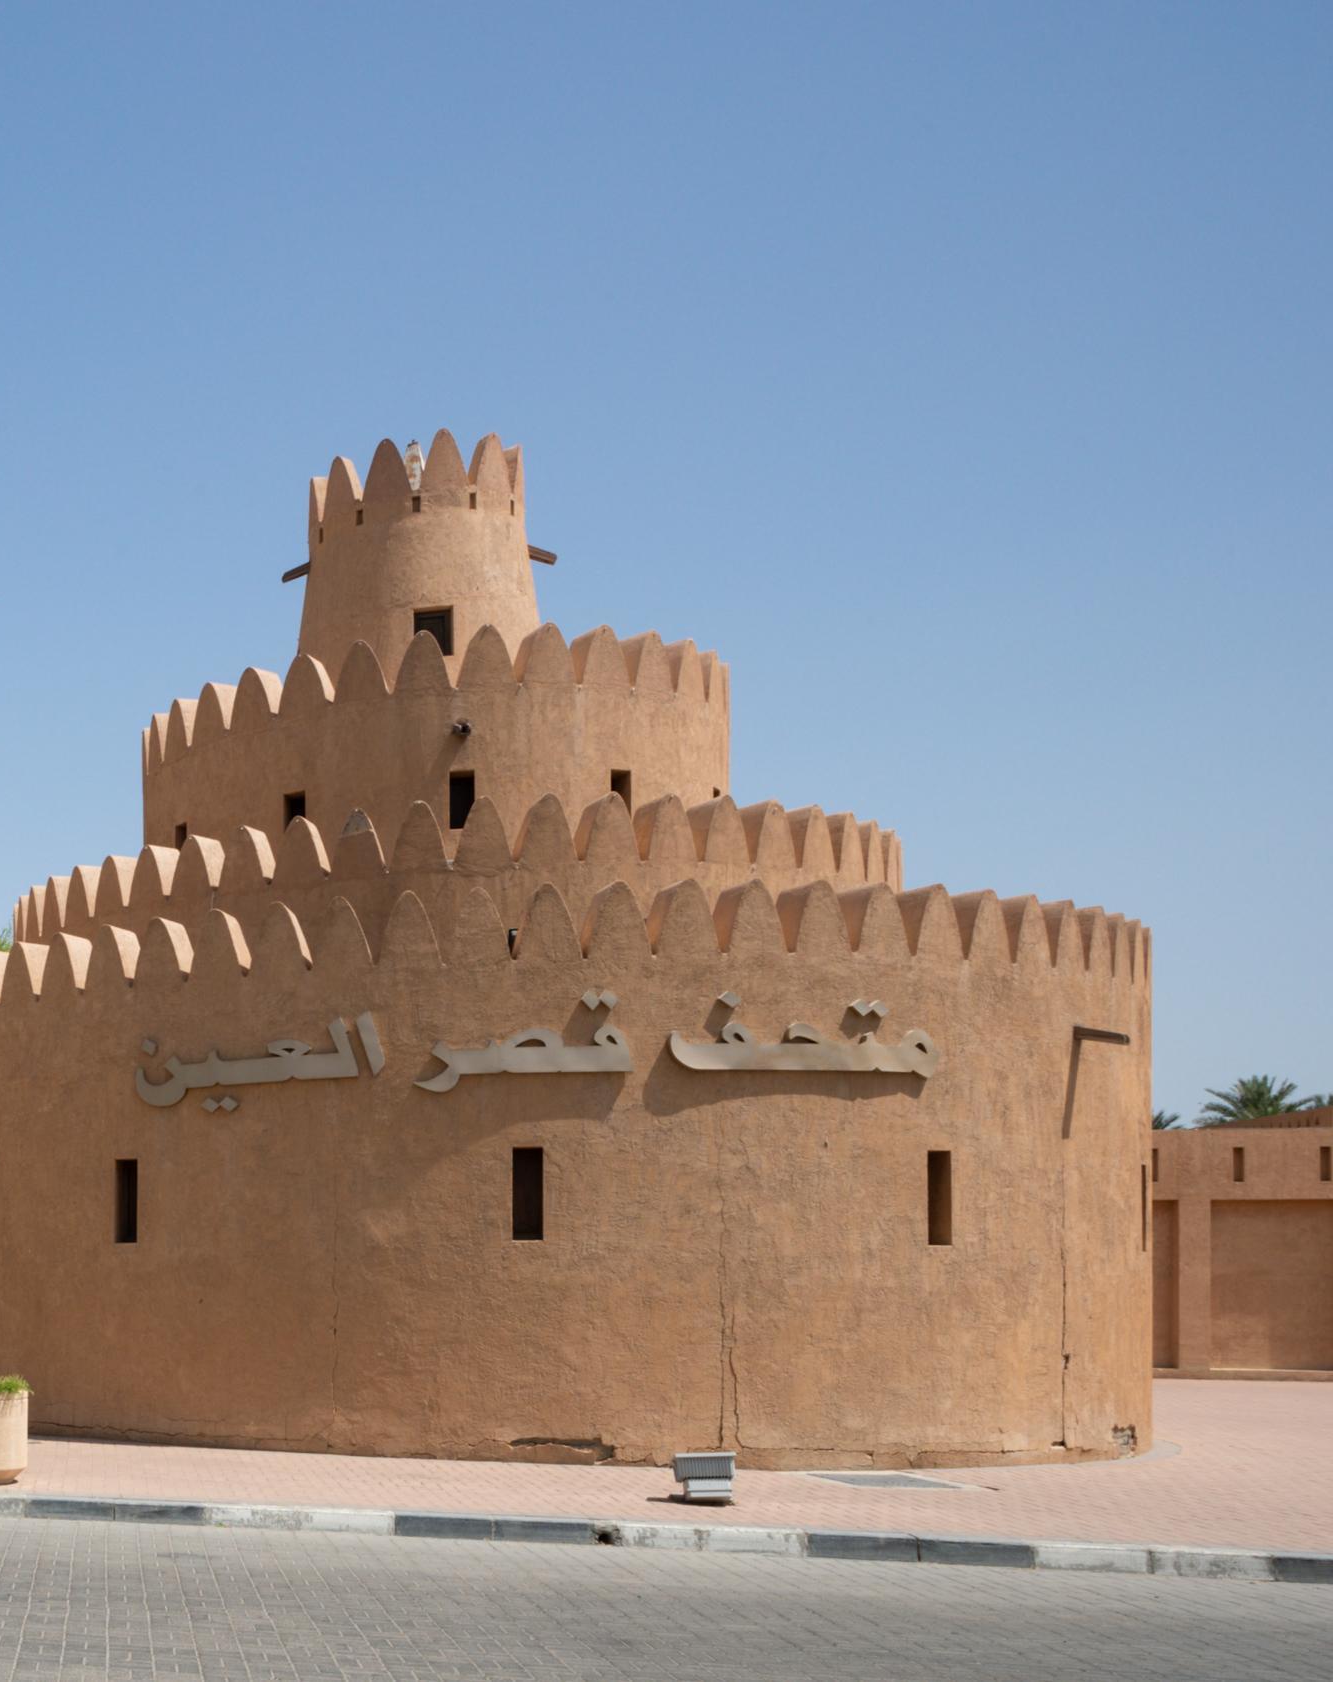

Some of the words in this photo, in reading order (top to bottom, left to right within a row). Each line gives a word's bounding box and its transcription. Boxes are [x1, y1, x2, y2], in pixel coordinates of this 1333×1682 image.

[135, 1010, 385, 1113] العين
[413, 990, 633, 1093] قصر
[670, 990, 939, 1078] متحف
